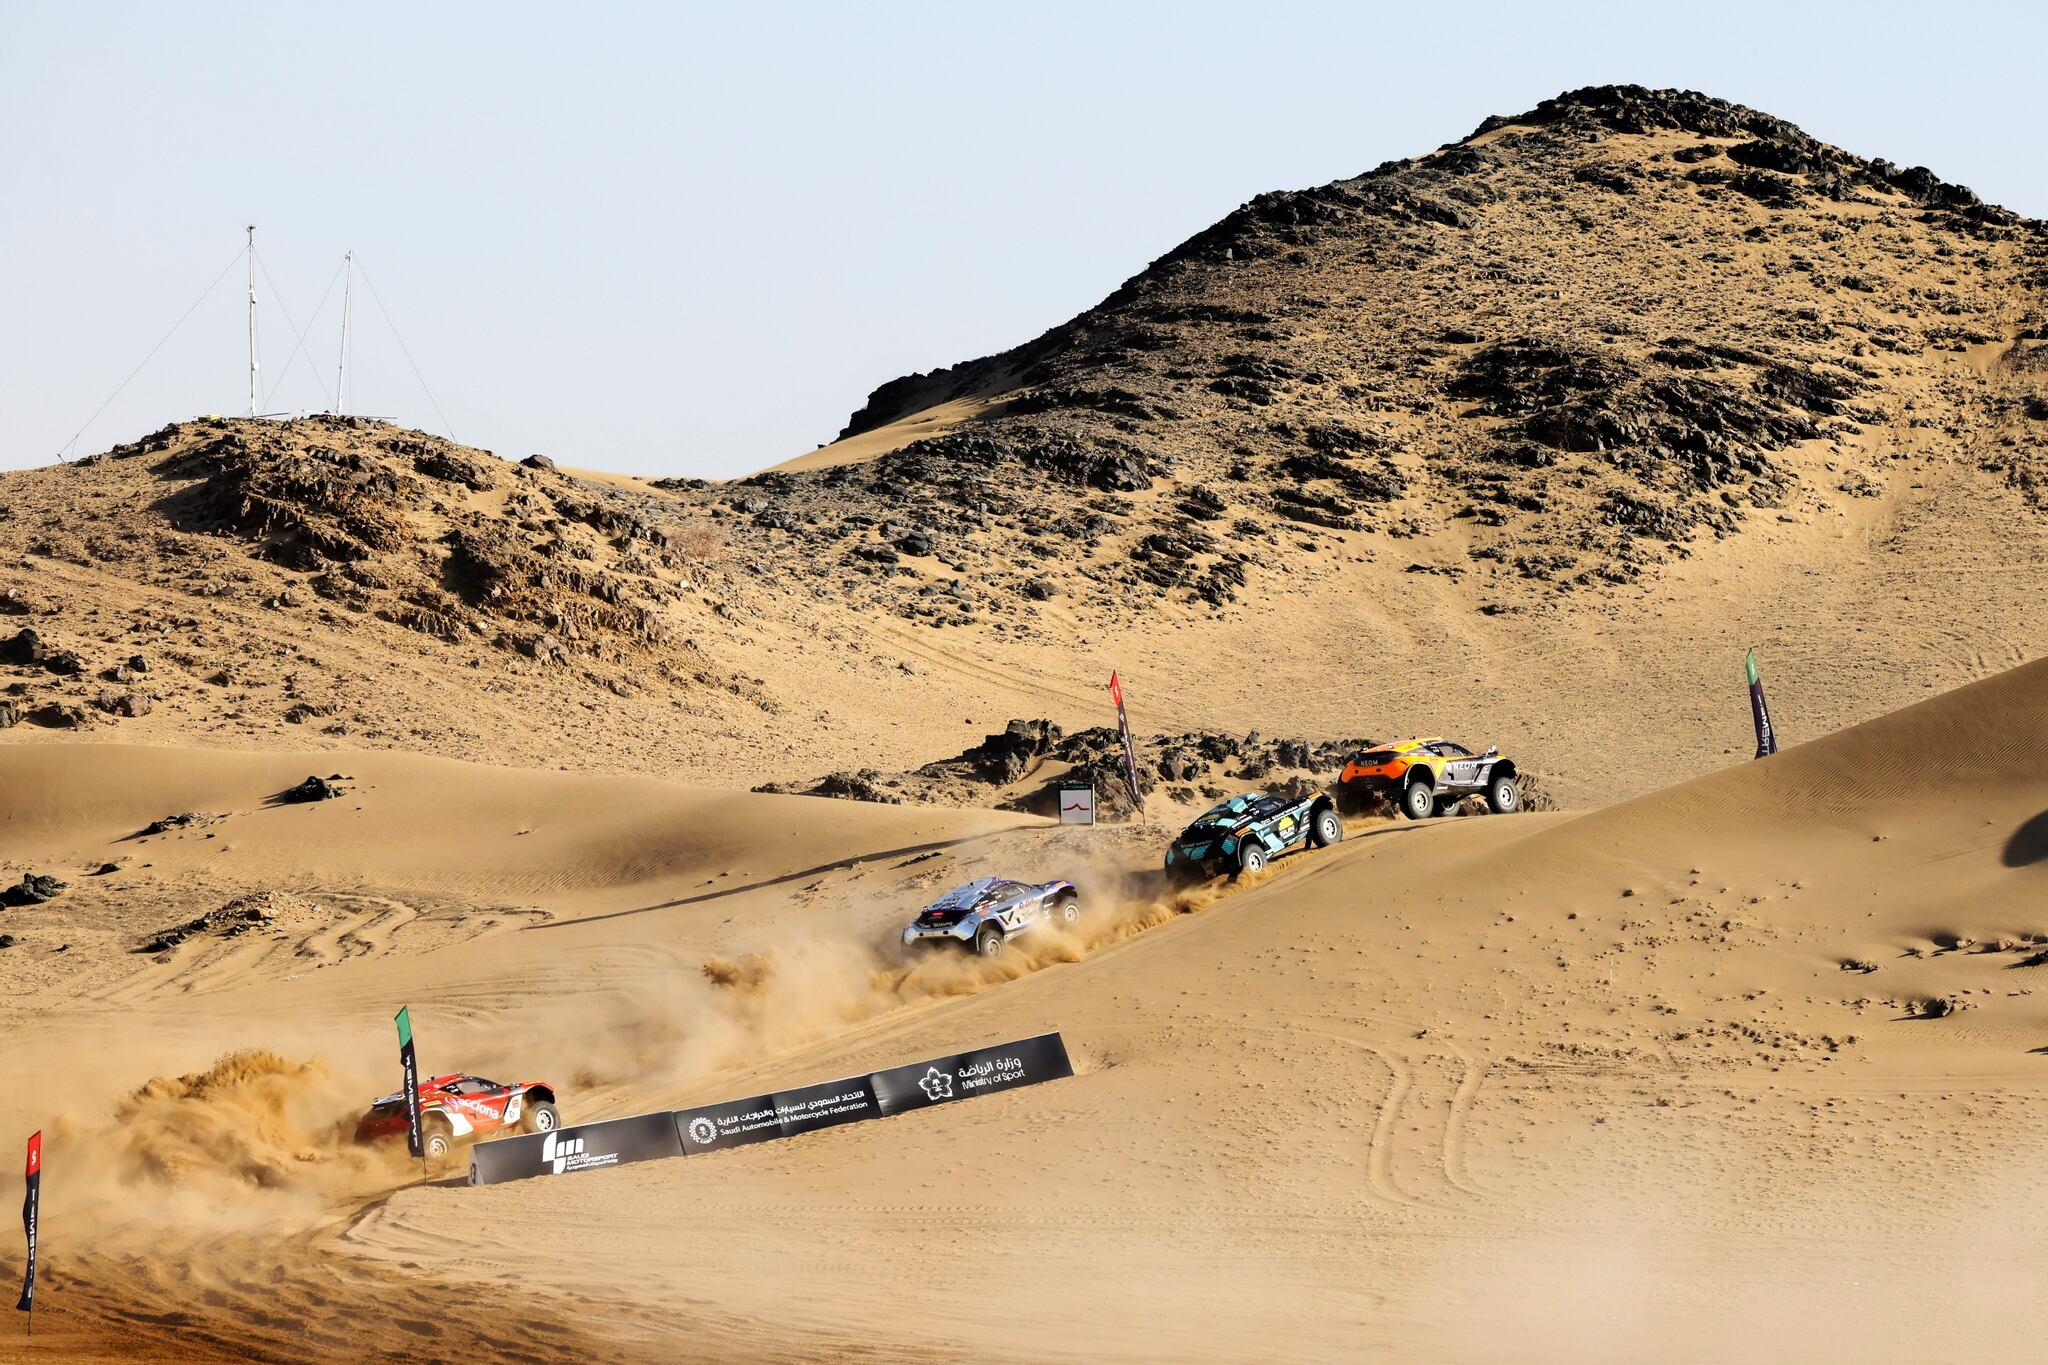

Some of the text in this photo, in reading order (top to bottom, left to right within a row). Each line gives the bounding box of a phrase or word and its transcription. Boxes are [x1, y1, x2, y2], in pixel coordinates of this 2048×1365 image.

[1360, 759, 1379, 767] NEOM
[1453, 762, 1478, 770] NEOM
[958, 1057, 1022, 1078] وزارة الرياضة
[961, 1069, 1026, 1090] Ministry of Sport
[457, 1097, 500, 1121] acciona
[808, 1095, 840, 1110] السعودي
[720, 1102, 868, 1136] Saudi Automobile & Motorcycle Federation
[566, 1153, 619, 1166] MOTORSPORT
[567, 1152, 590, 1160] SAUDI
